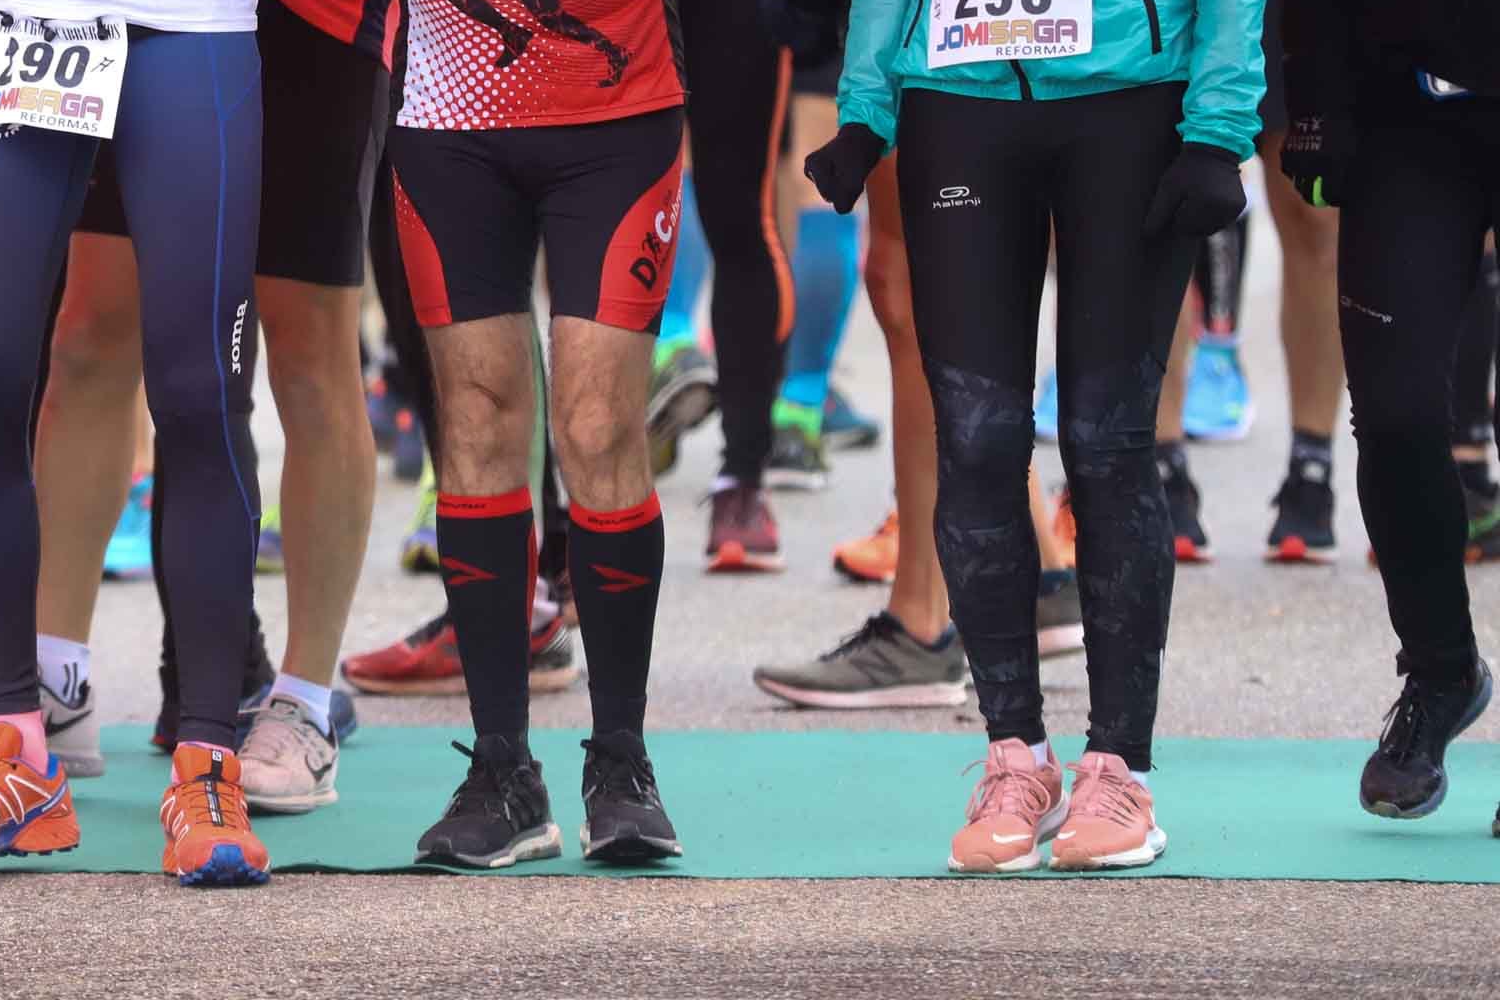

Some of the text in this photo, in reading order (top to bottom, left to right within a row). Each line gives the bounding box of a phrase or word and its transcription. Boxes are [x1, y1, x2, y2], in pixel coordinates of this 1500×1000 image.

[56, 23, 121, 42] CABREROS
[936, 18, 1078, 52] JOMISAGA
[995, 44, 1076, 57] REFORMAS
[20, 111, 100, 133] REFORMAS
